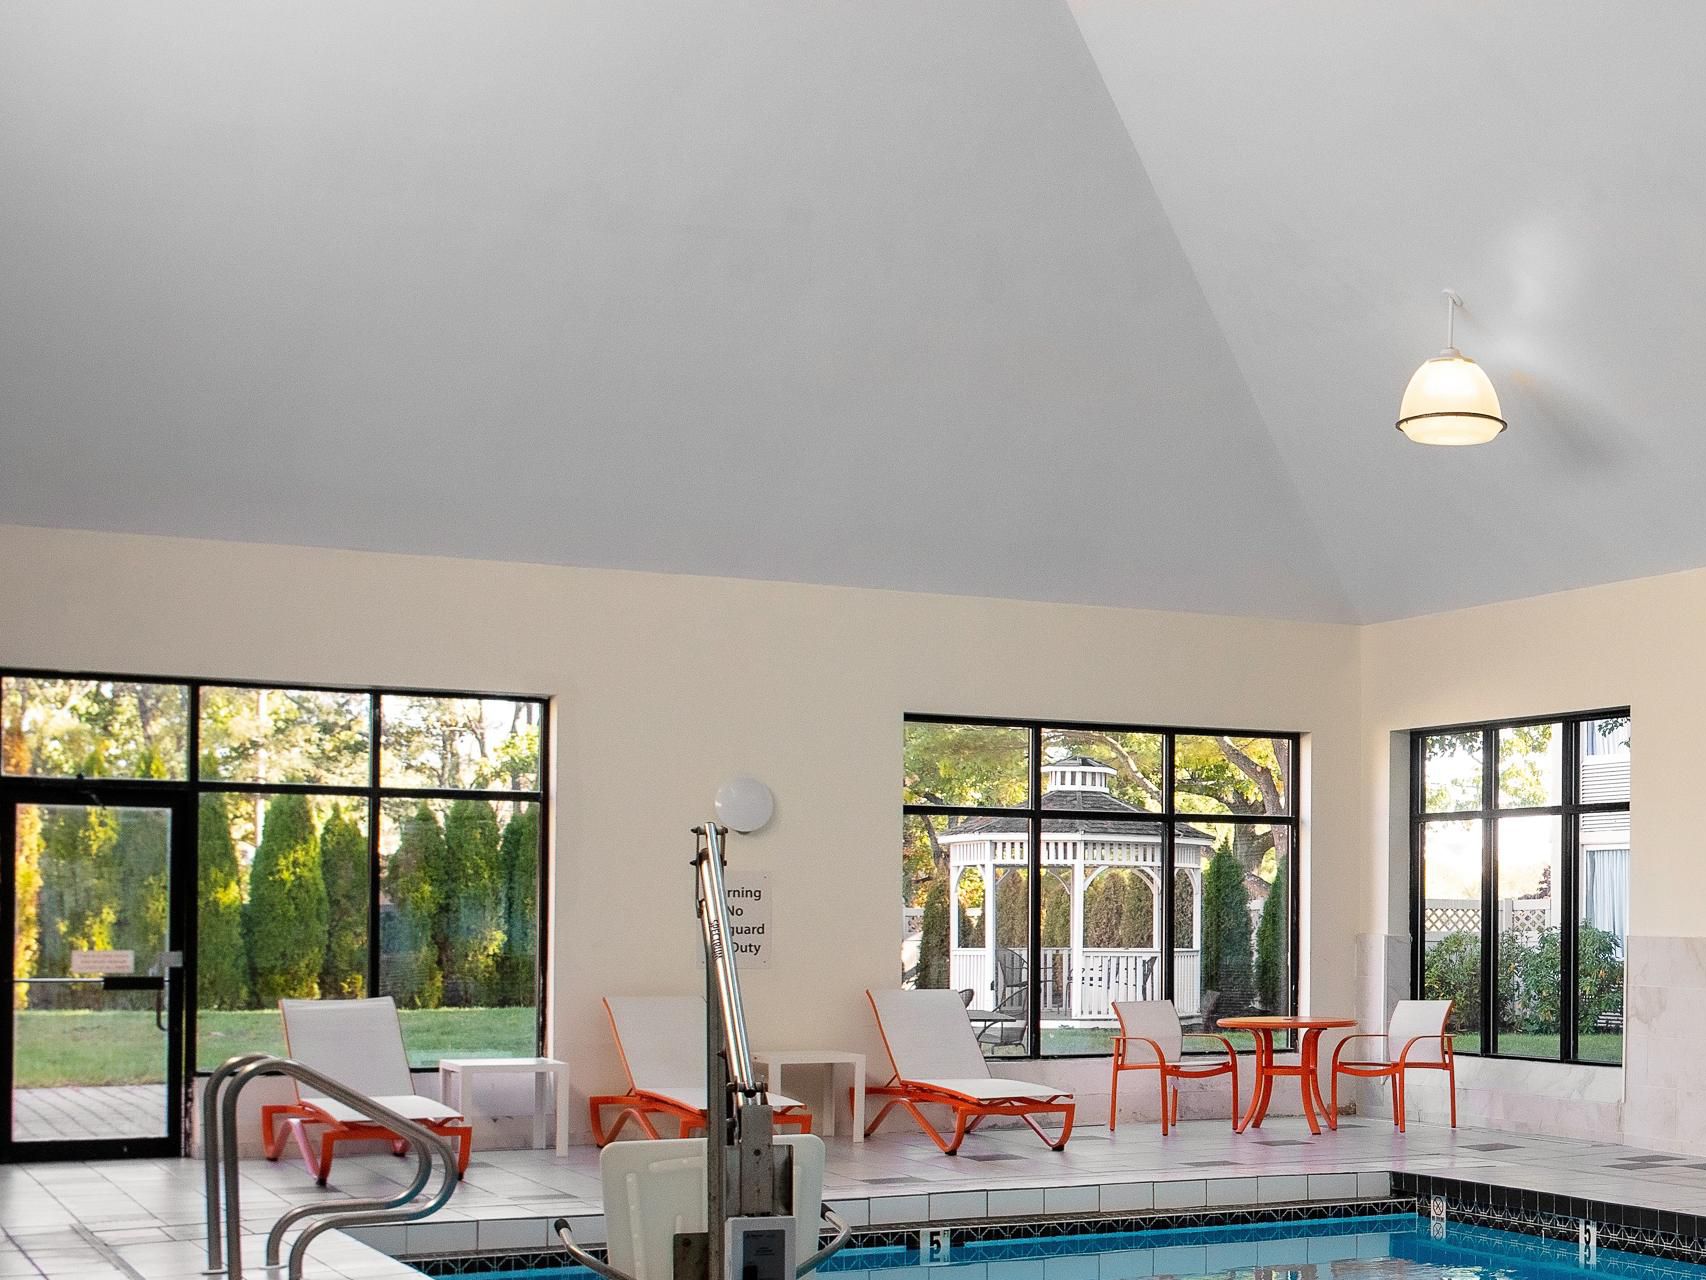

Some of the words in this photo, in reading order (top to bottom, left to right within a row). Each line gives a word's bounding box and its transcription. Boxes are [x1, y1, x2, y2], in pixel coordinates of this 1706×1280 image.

[727, 887, 762, 901] rning
[727, 905, 744, 917] No
[733, 942, 761, 956] Duty
